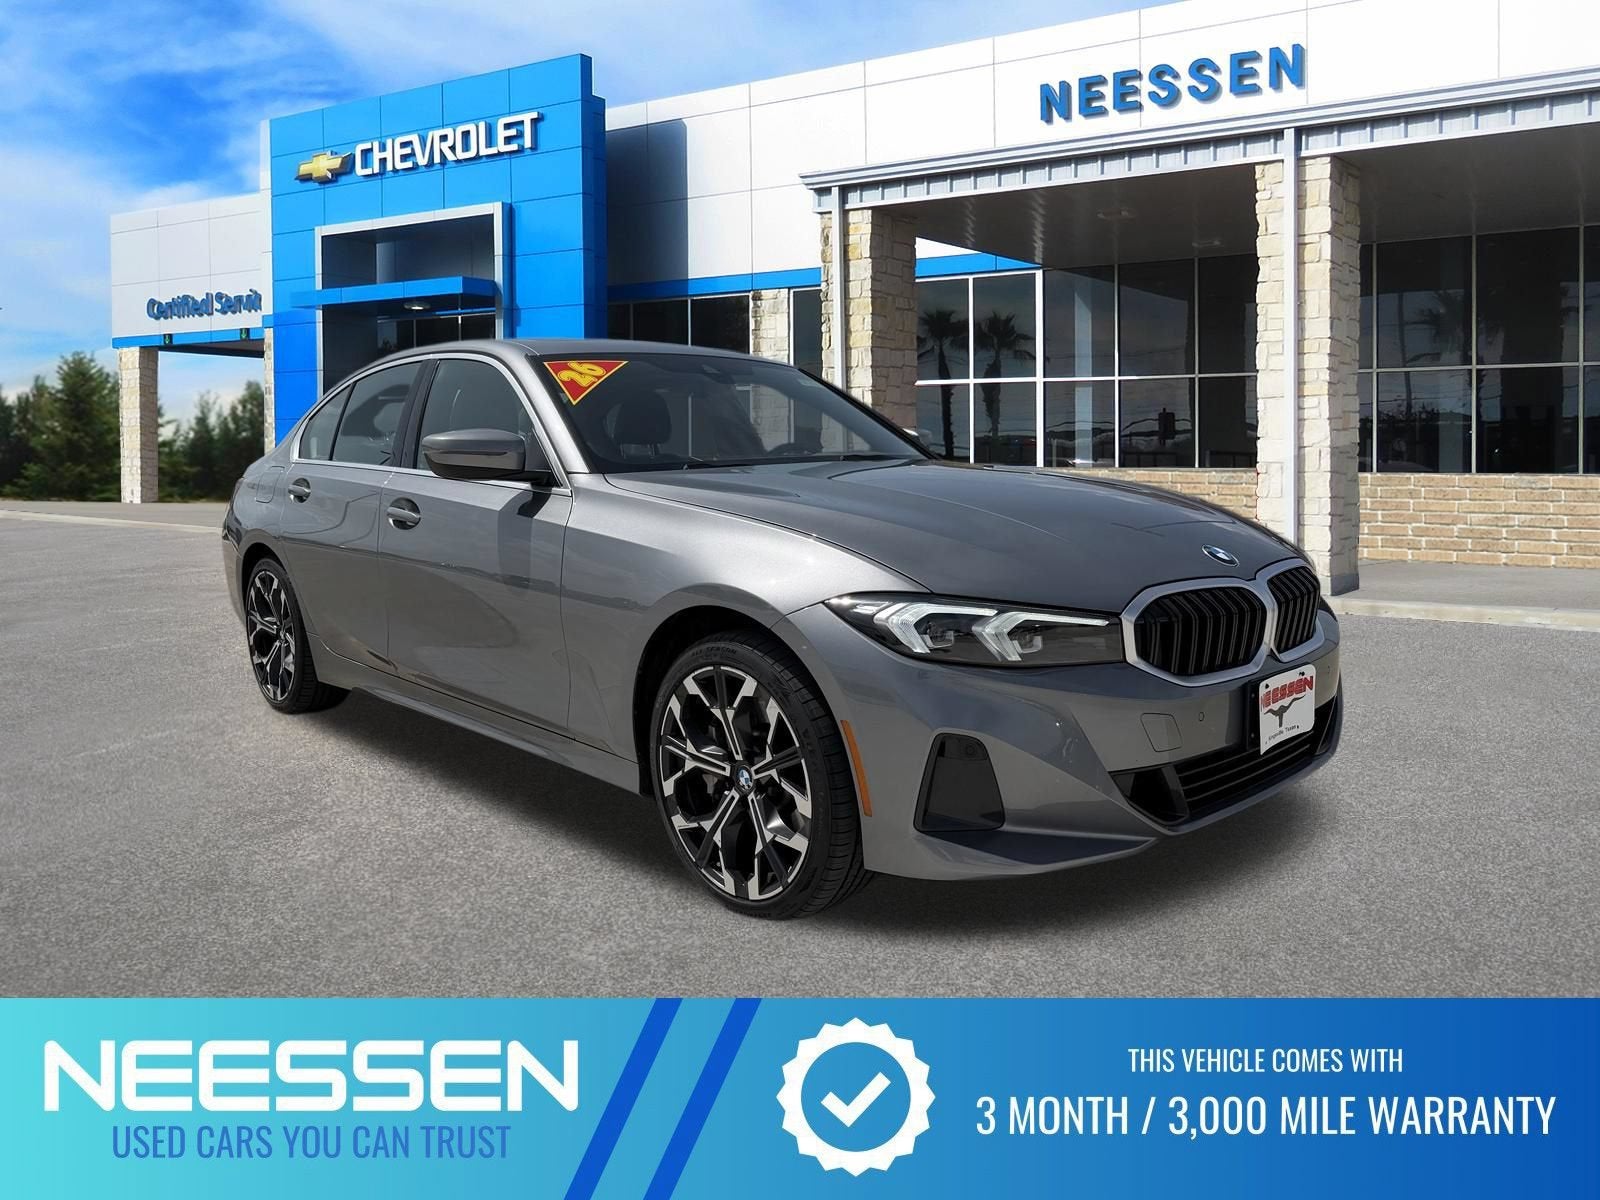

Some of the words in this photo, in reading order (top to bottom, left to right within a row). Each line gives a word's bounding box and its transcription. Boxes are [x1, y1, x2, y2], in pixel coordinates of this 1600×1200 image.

[1039, 44, 1305, 125] NEESSEN
[355, 111, 539, 177] CHEVROLET
[146, 292, 214, 320] Certified
